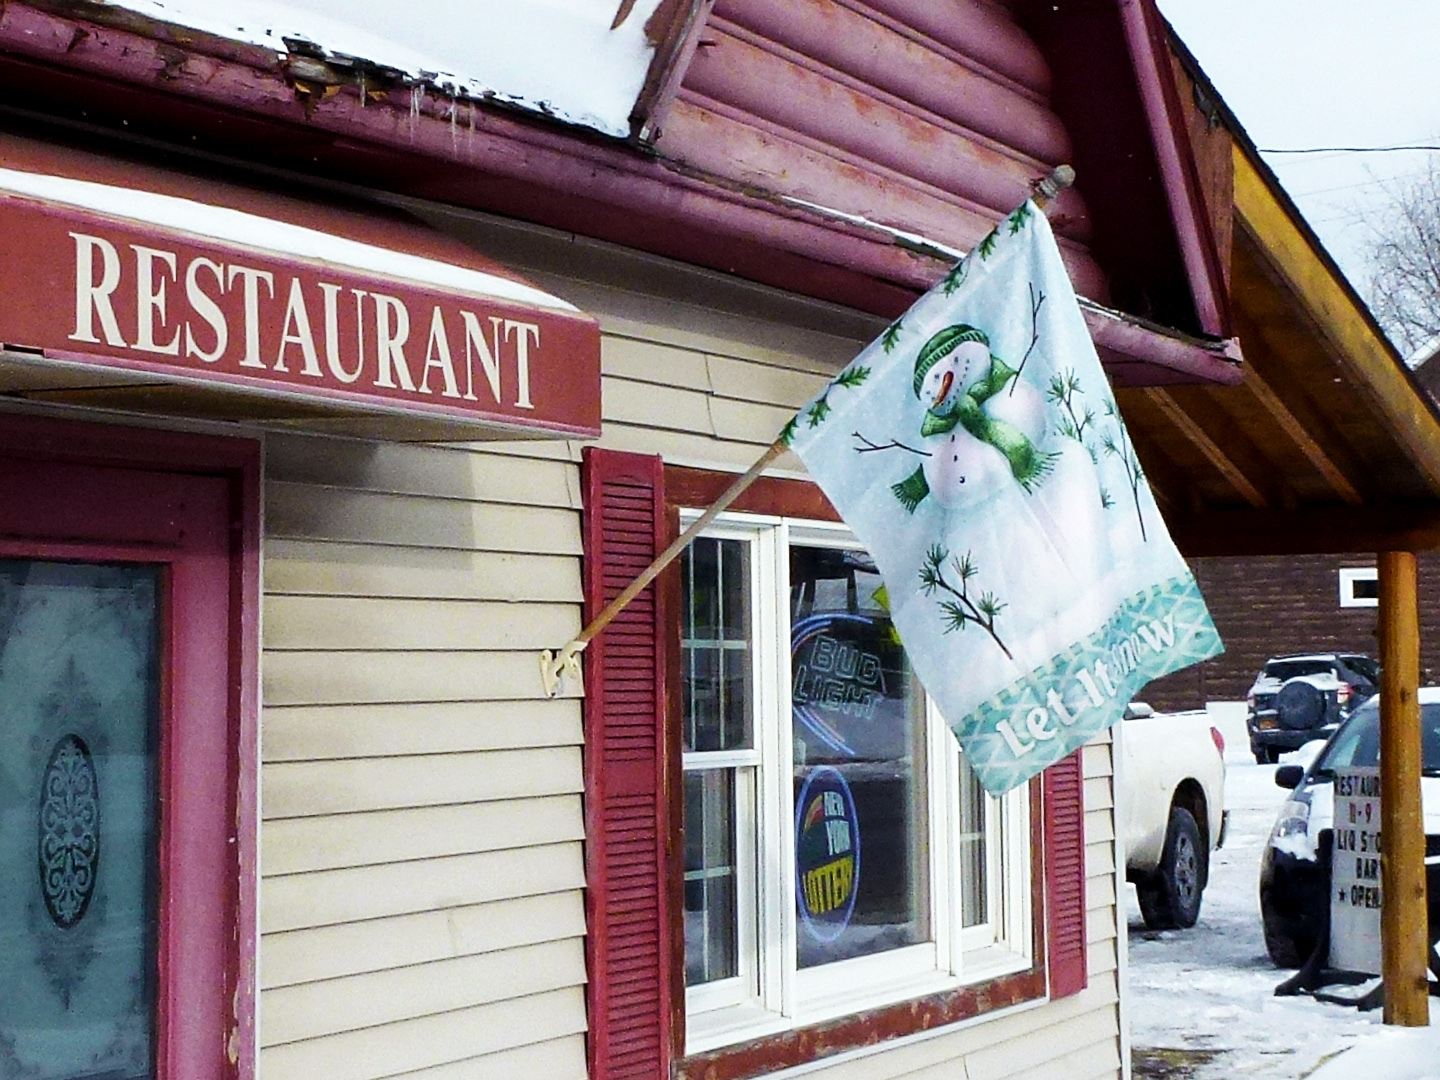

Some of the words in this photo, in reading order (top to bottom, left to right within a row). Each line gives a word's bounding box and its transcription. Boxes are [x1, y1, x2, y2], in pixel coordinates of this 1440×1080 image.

[67, 231, 540, 410] RESTAURANT
[810, 634, 881, 686] BUD
[995, 686, 1085, 758] Let
[1075, 658, 1118, 708] It
[1333, 775, 1382, 797] RESTAUR
[1361, 830, 1383, 854] STO
[1356, 857, 1378, 880] BAR
